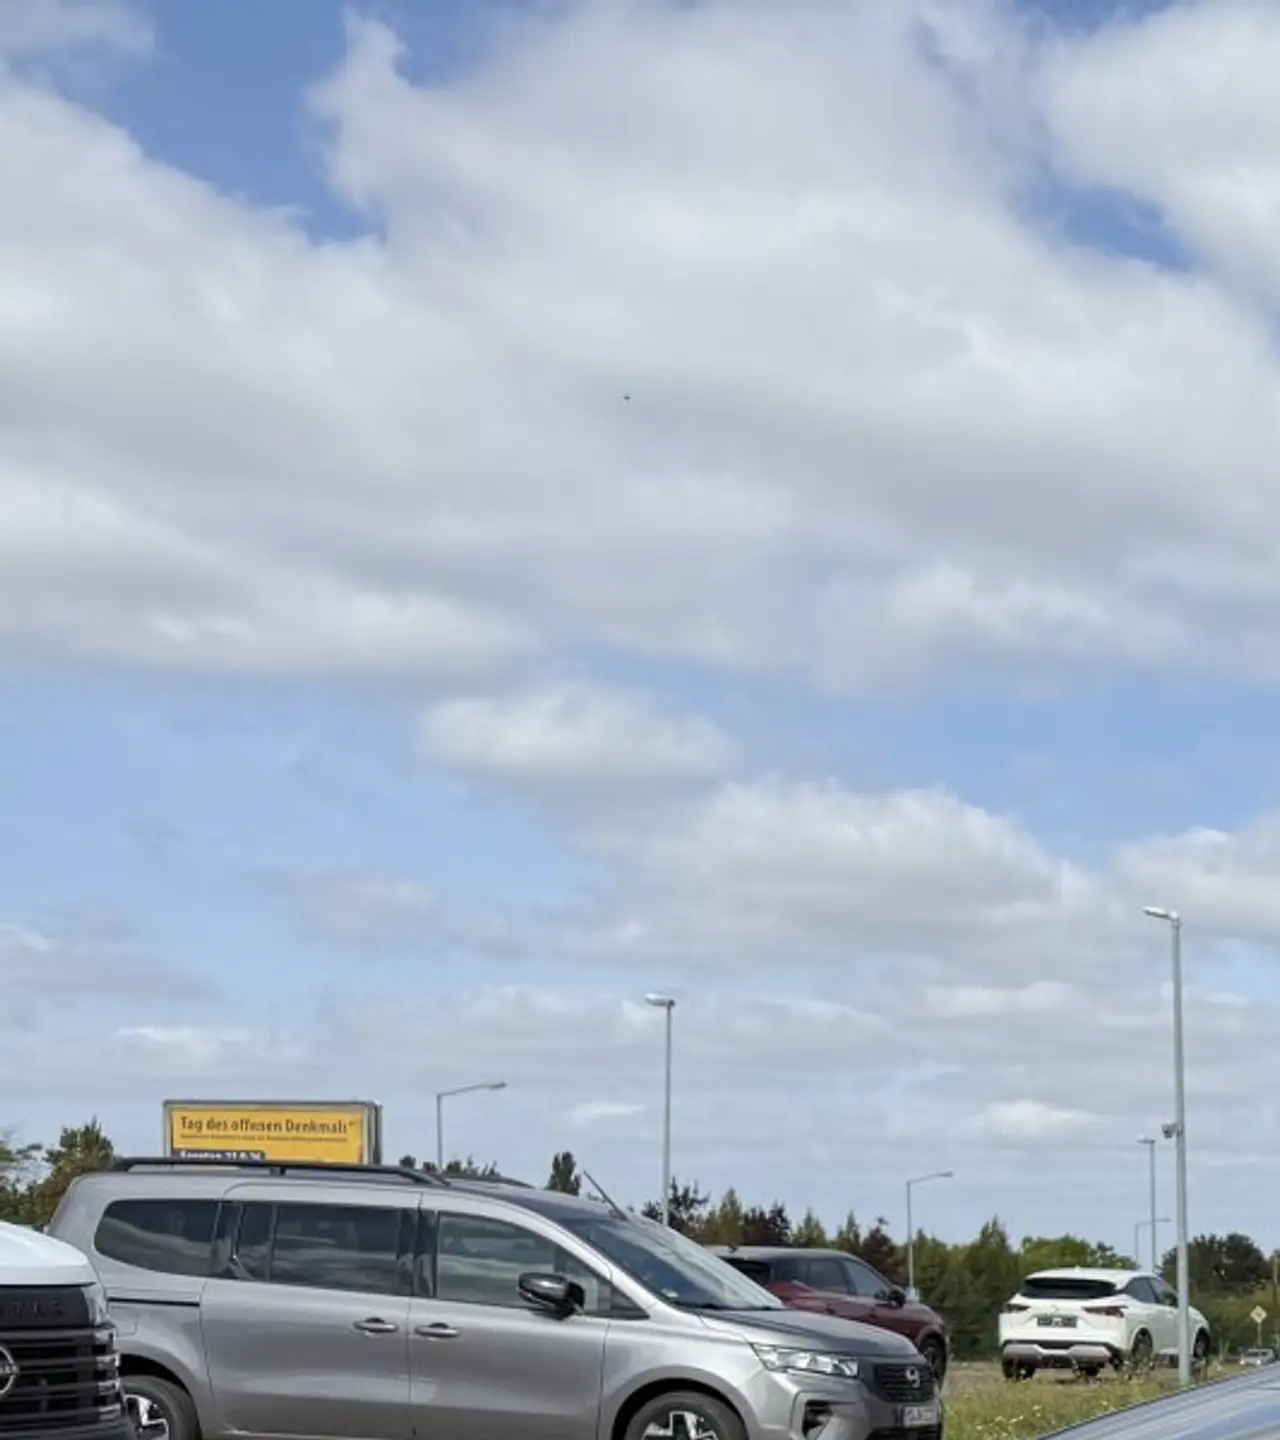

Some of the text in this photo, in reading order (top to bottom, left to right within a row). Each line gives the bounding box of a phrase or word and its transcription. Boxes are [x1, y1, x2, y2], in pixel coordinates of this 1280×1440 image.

[180, 1116, 202, 1133] Tag
[206, 1117, 227, 1131] des
[230, 1118, 282, 1132] offenen
